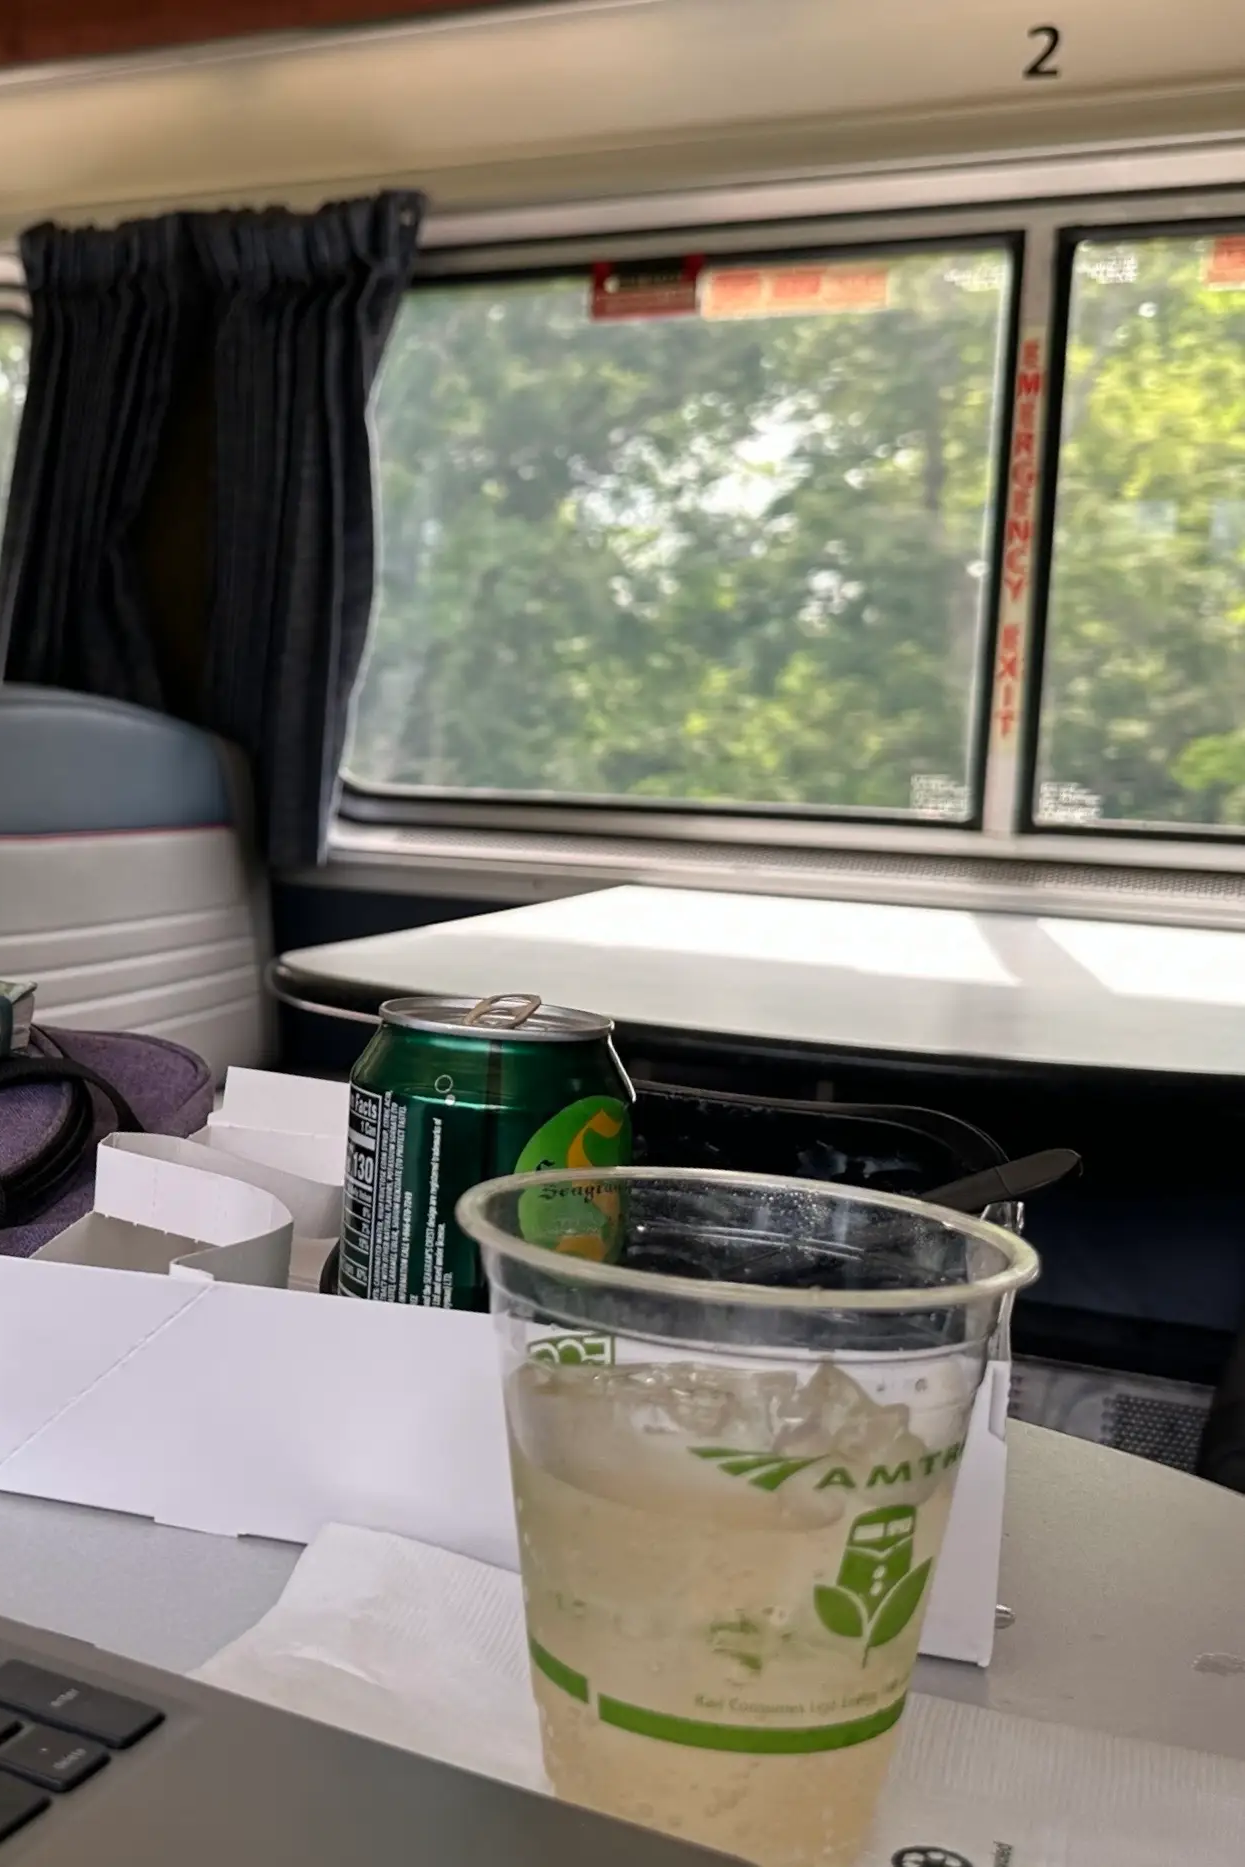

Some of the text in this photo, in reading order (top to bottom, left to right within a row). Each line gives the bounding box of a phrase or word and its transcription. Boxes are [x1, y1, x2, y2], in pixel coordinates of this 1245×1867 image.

[1022, 25, 1061, 80] 2
[995, 339, 1043, 738] EMERGENCY EXIT
